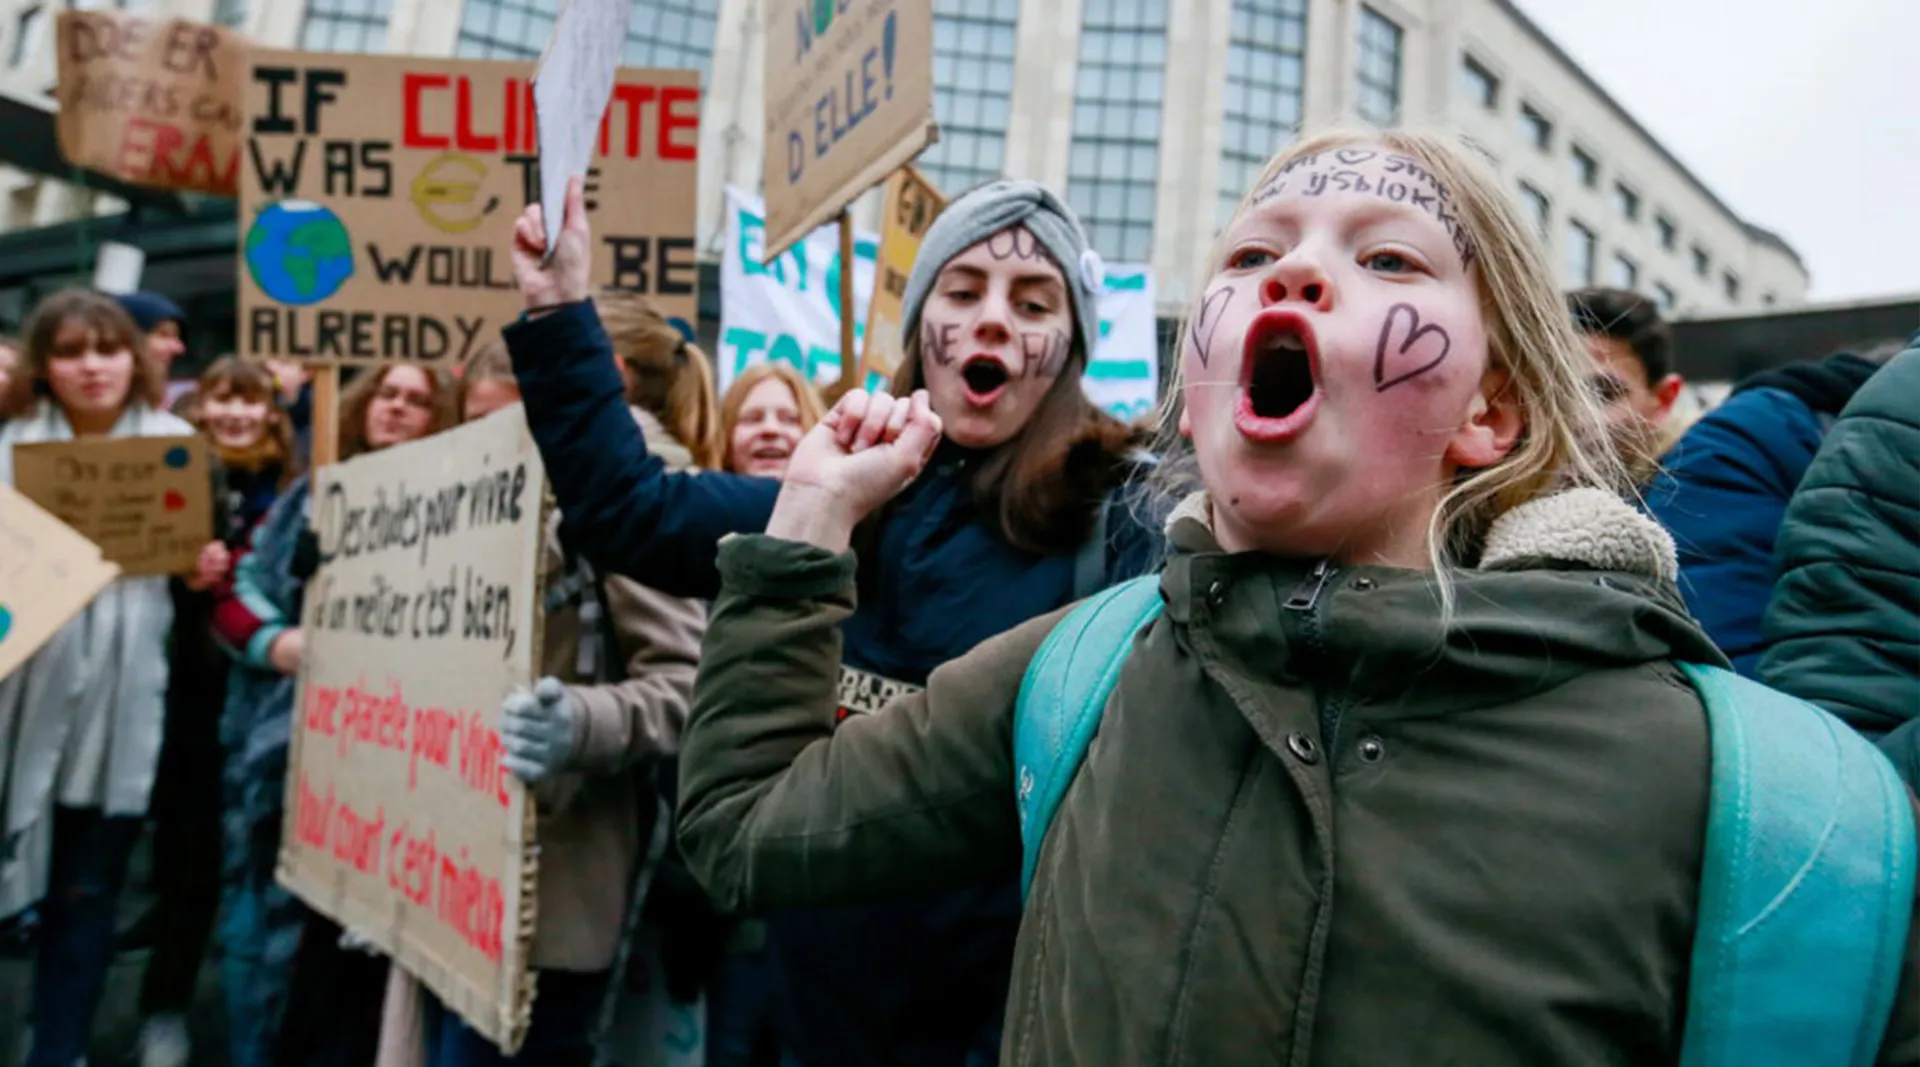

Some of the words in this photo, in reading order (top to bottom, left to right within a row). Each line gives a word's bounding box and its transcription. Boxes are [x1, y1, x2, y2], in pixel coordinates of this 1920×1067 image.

[253, 65, 346, 134] IF
[402, 73, 700, 163] CLITE
[247, 138, 393, 197] WAS
[503, 155, 600, 211] TE
[366, 241, 522, 291] WOUL
[602, 235, 695, 294] BE
[250, 306, 484, 361] ALREADY
[318, 481, 364, 562] Des
[419, 481, 466, 568] pour
[467, 453, 526, 529] vivre
[412, 564, 457, 639] c'est
[462, 565, 516, 662] bien,
[305, 682, 338, 737] une
[408, 707, 462, 792] pour
